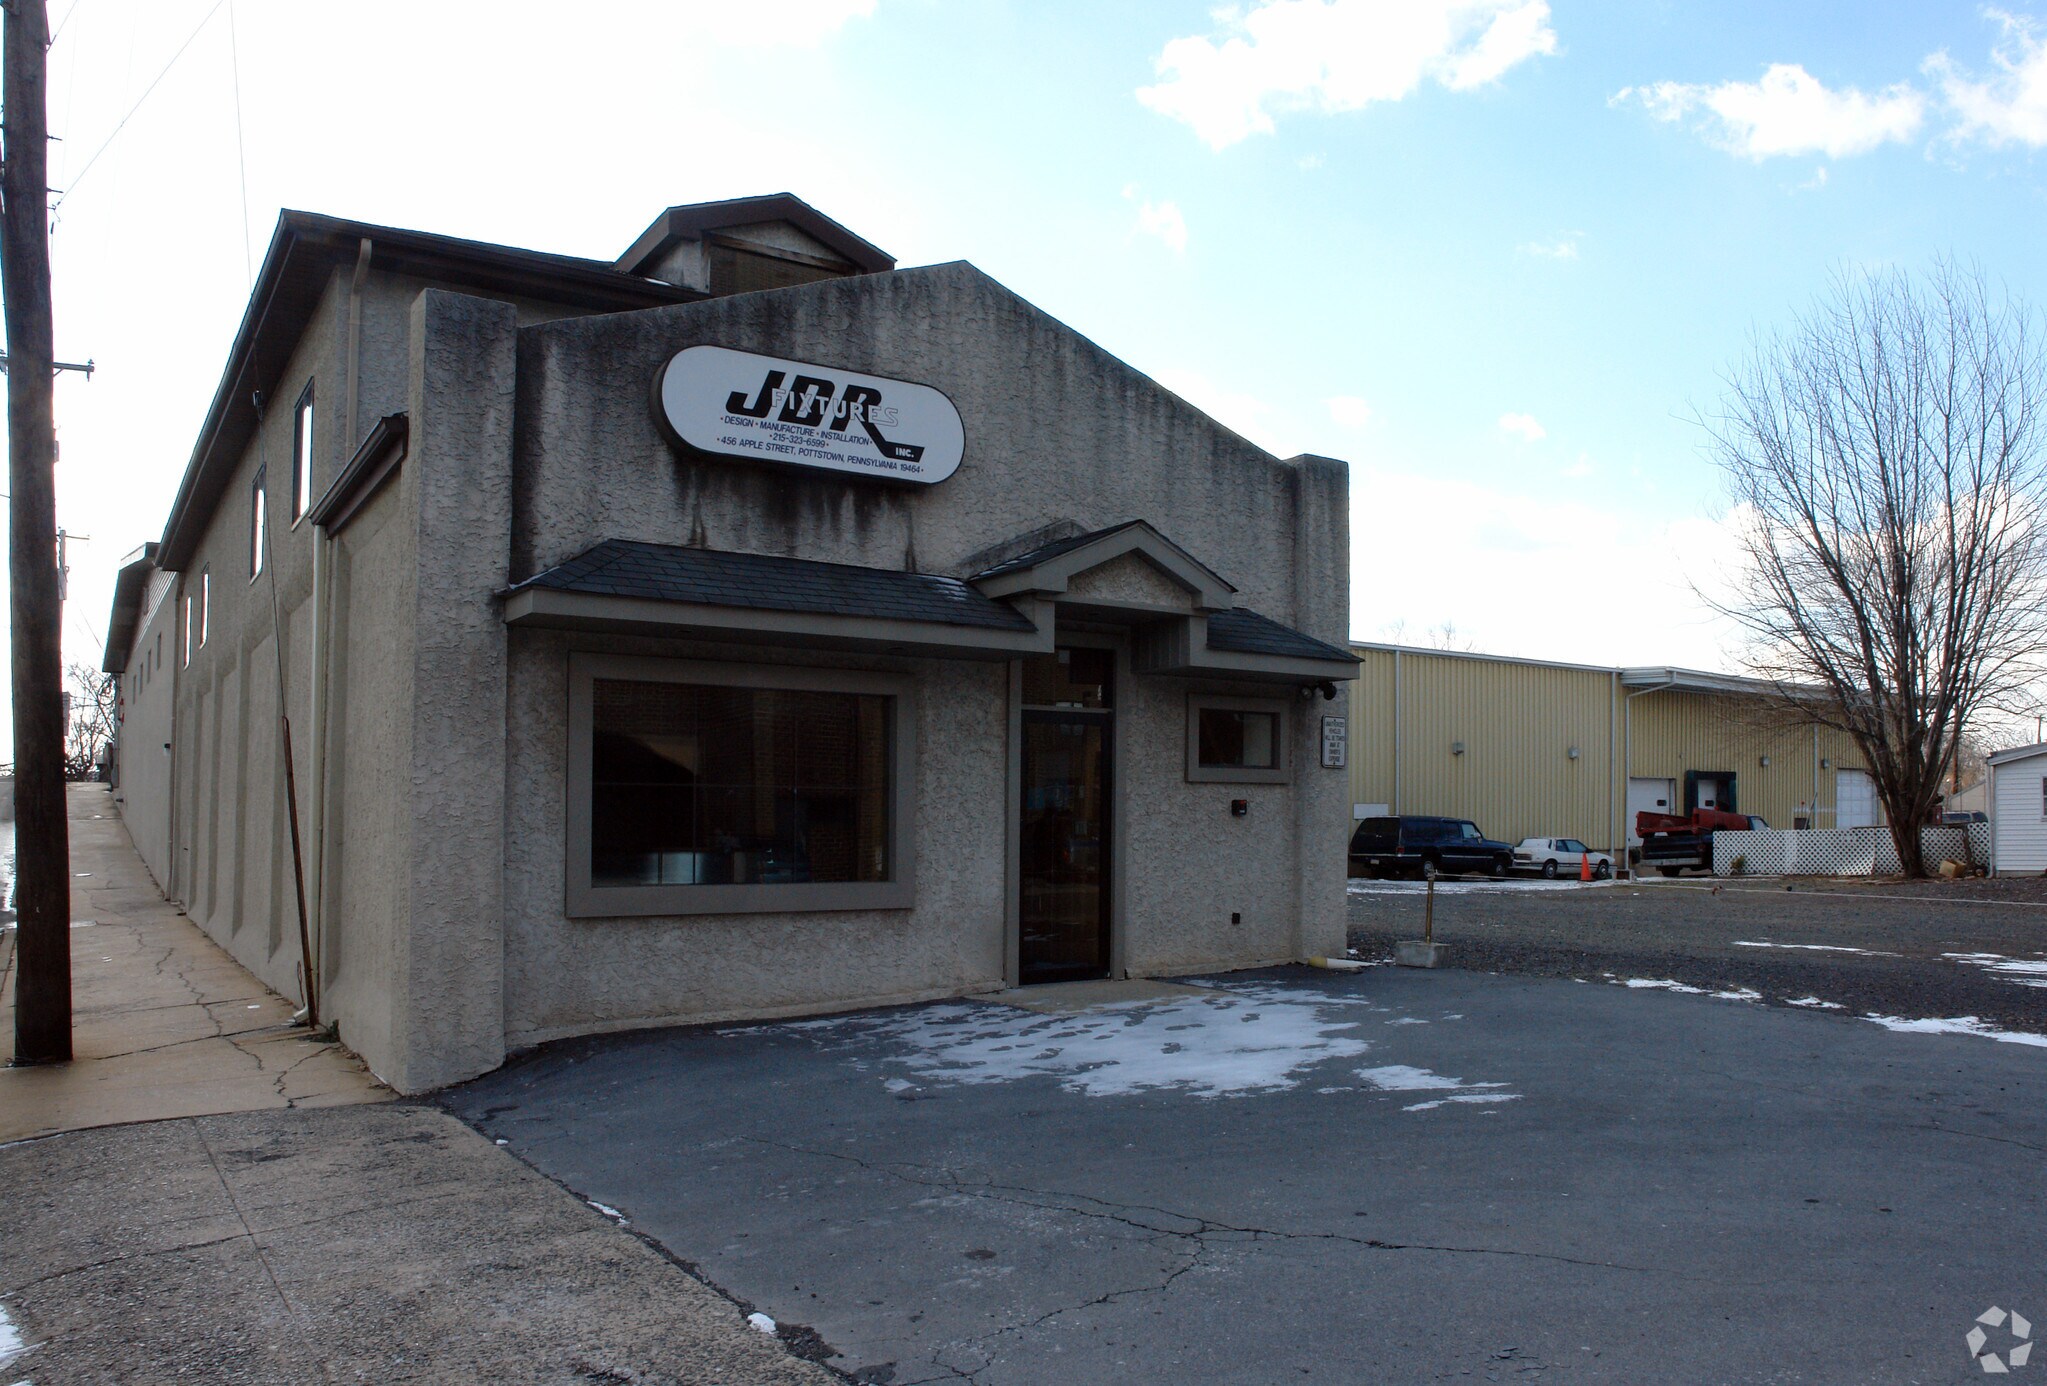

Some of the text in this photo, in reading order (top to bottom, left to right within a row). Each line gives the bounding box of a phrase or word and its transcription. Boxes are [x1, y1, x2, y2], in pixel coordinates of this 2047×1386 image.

[726, 370, 890, 455] JDR
[772, 388, 899, 427] FIXTURES
[725, 415, 870, 446] DESIGN MANUFACTURE INSTALLATION
[773, 433, 826, 448] 215-323-6599
[721, 436, 920, 474] 456 APPLE STREET, POTTSTOWN, PENNSYLVANIA 19464
[895, 447, 915, 458] INC.
